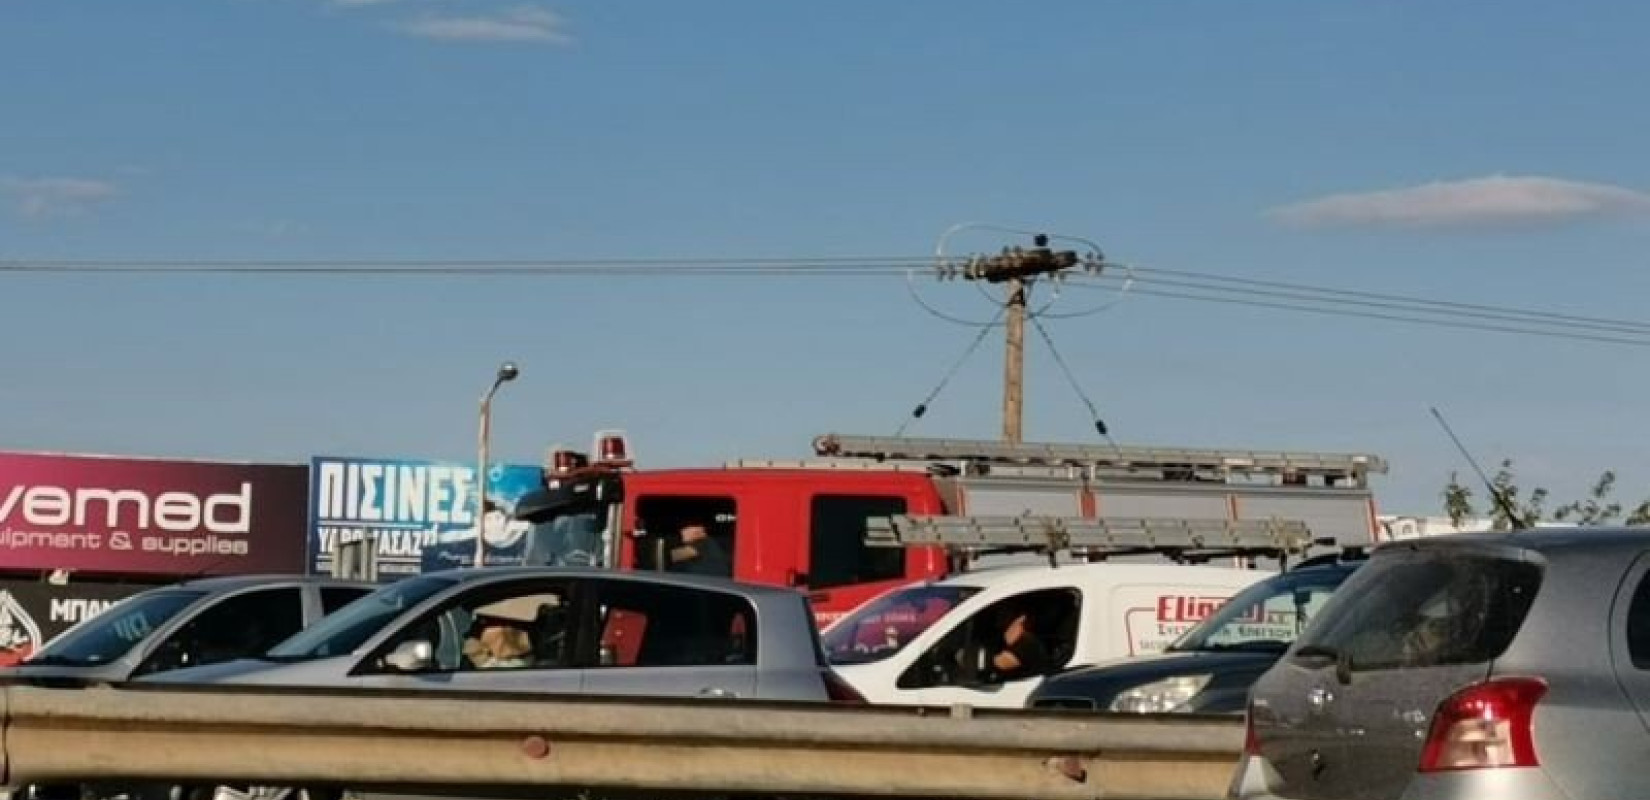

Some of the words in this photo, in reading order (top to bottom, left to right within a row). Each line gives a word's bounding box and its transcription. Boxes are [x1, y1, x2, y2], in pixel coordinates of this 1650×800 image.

[319, 462, 474, 524] ΠΙΣΙΝΕΣ
[109, 531, 132, 550] &
[142, 535, 248, 556] supplies
